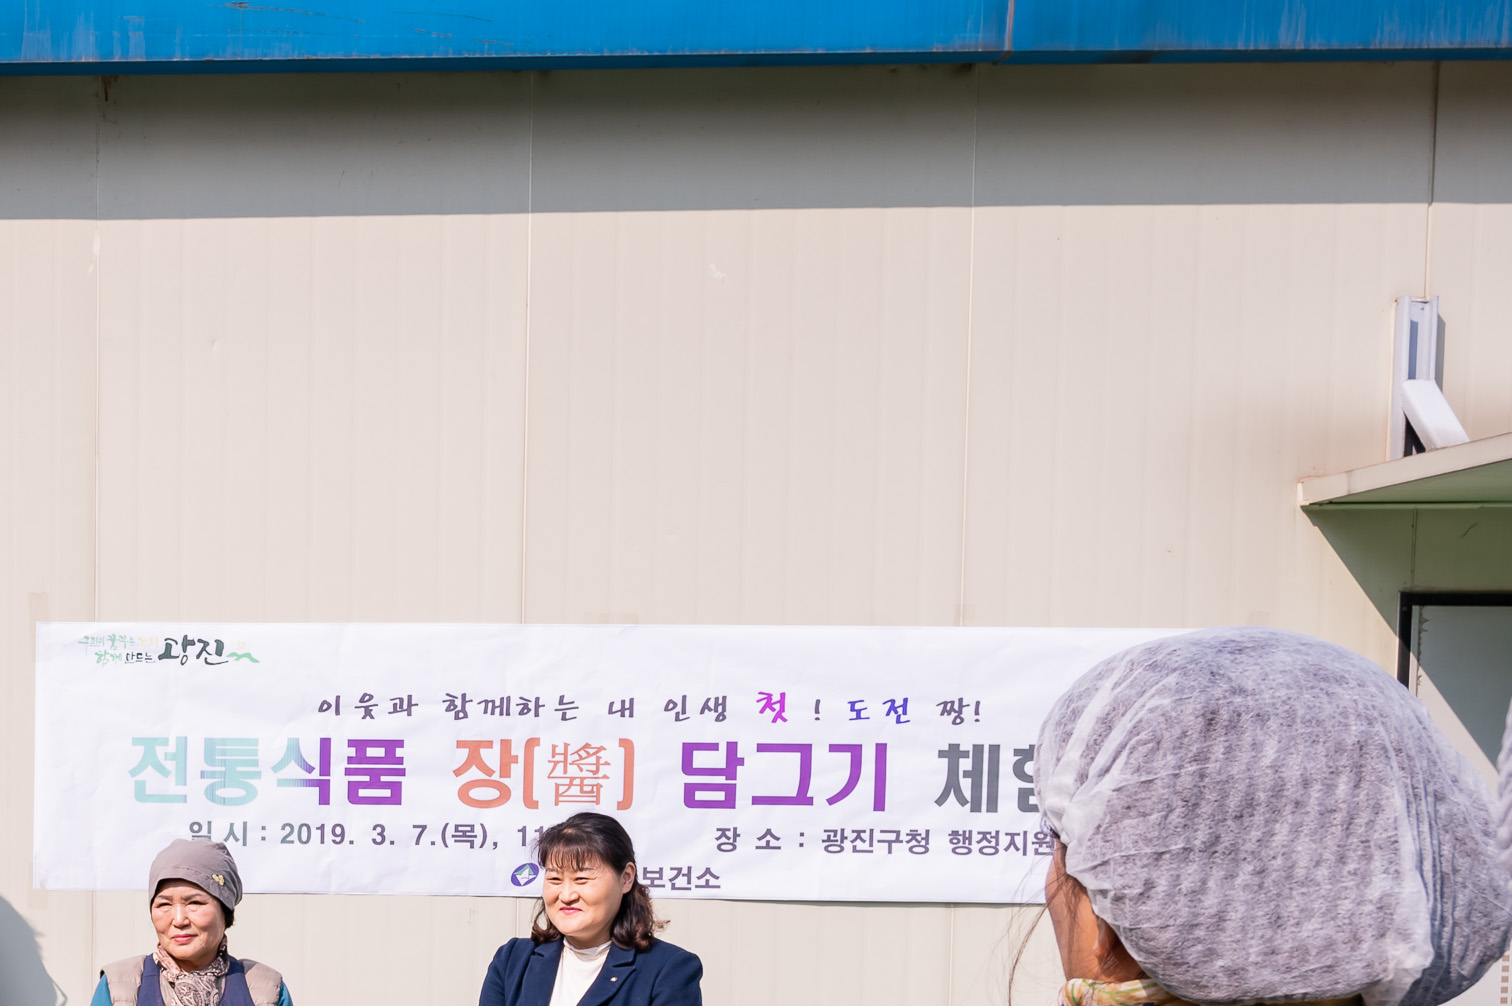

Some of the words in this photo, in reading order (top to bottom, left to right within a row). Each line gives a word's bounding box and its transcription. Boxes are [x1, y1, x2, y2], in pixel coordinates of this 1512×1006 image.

[157, 634, 229, 666] 광진
[317, 692, 419, 720] 이웃과
[441, 692, 580, 722] 함께하는
[607, 697, 635, 719] 내
[663, 694, 728, 723] 인생
[755, 691, 789, 724] 첫
[847, 696, 911, 725] 도전
[935, 697, 981, 726] 짱!
[128, 736, 407, 806] 전통식품
[680, 740, 888, 813] 담그기
[280, 822, 355, 846] 2019.
[371, 823, 395, 846] 3.
[821, 827, 931, 855] 광진구청
[641, 865, 721, 892] 보건소
